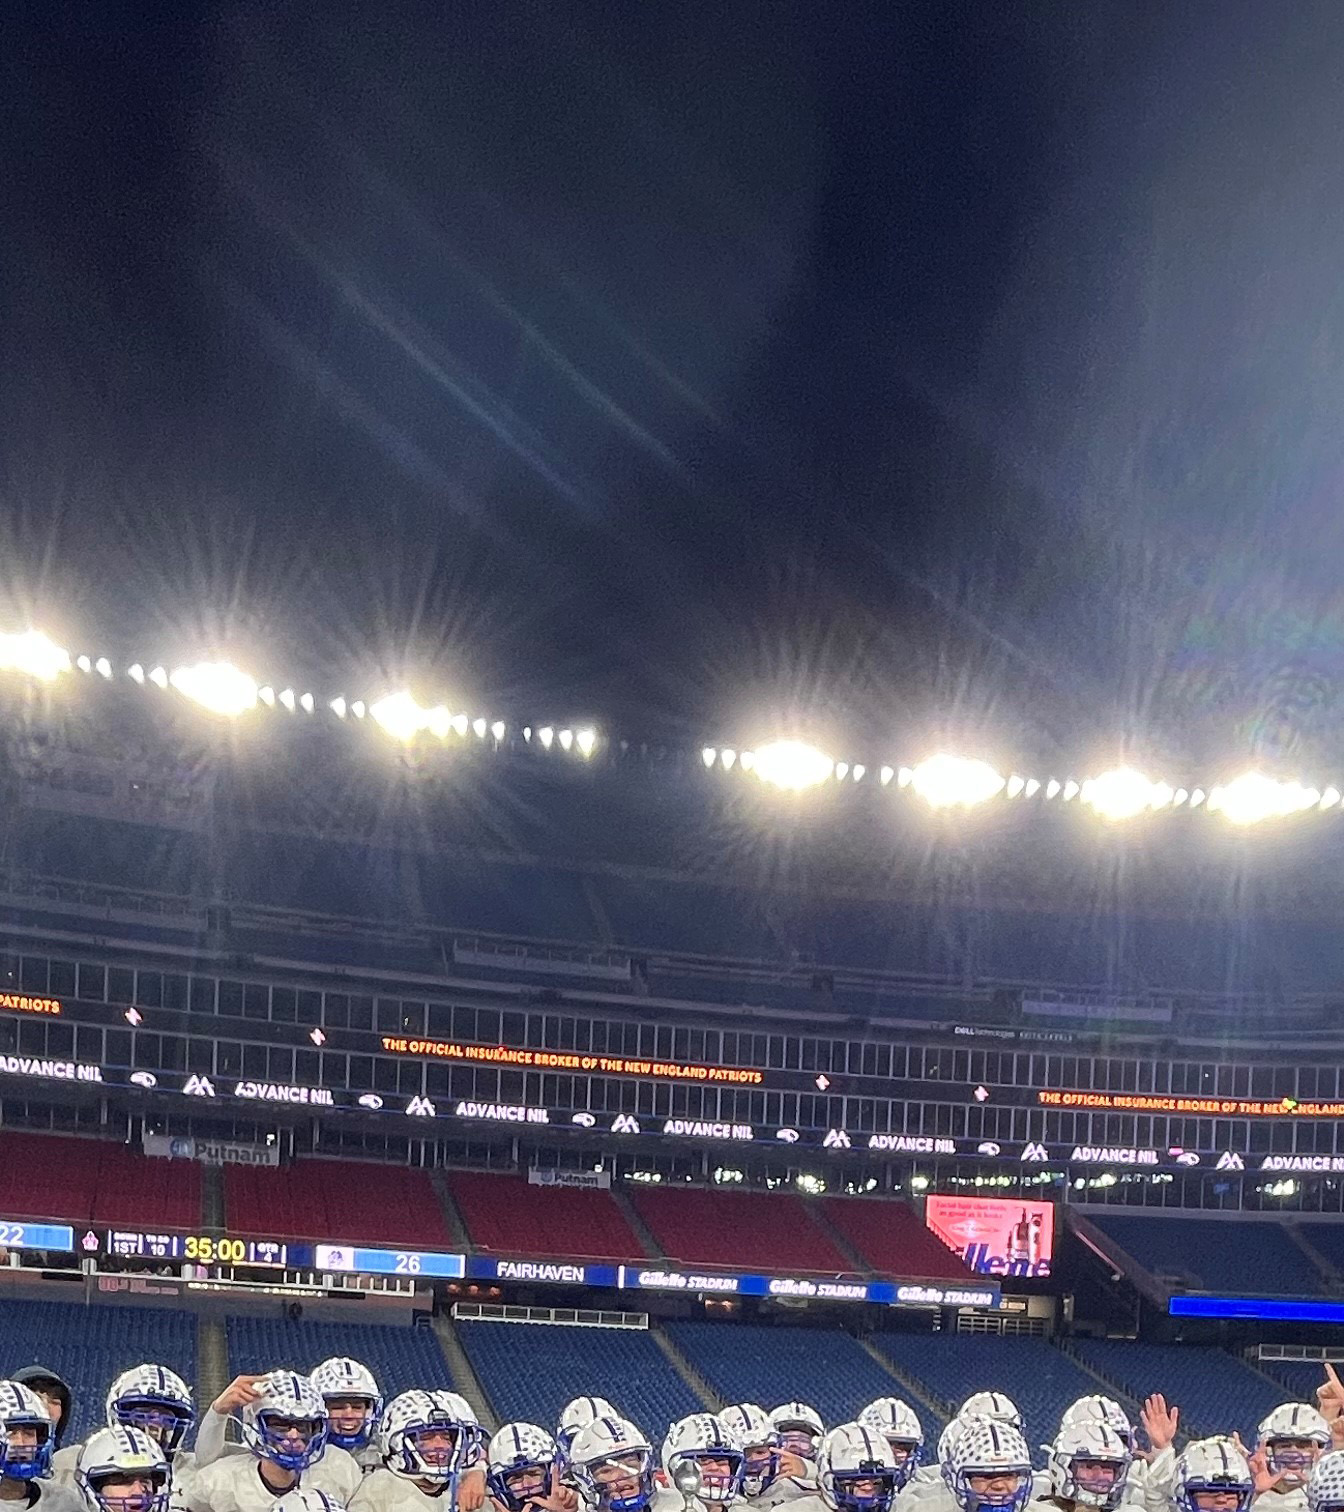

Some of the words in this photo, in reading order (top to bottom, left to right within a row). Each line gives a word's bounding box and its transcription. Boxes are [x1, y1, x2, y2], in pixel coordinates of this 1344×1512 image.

[382, 1038, 407, 1051] THE
[409, 1041, 463, 1057] OFFICIAL
[466, 1047, 532, 1064] INSURANCE
[535, 1053, 580, 1067] BROKER
[582, 1057, 597, 1069] OF
[600, 1059, 622, 1072] THE
[625, 1062, 651, 1074] NEW
[653, 1064, 706, 1078] ENGLAND
[709, 1068, 762, 1083] PATRIOTS
[78, 1066, 102, 1081] NIL
[235, 1081, 308, 1102] ADVANCE
[311, 1089, 334, 1104] NIL
[1039, 1092, 1060, 1104] THE
[1063, 1094, 1111, 1106] OFFICIAL
[1114, 1096, 1175, 1109] INSURANCE
[1177, 1100, 1219, 1111] BROKER
[1222, 1102, 1237, 1112] OF
[1239, 1102, 1260, 1113] THE
[456, 1102, 525, 1122] ADVANCE
[527, 1109, 549, 1123] NIL
[664, 1120, 730, 1138] ADVANCE
[733, 1125, 754, 1139] NIL
[869, 1134, 933, 1152] ADVANCE
[935, 1138, 956, 1153] NIL
[194, 1143, 270, 1164] Putnam
[1072, 1146, 1136, 1163] ADVANCE
[1138, 1150, 1159, 1164] NIL
[1261, 1156, 1330, 1170] ADVANCE
[151, 1243, 166, 1256] 10
[184, 1236, 246, 1261] 35:00
[396, 1254, 420, 1273] 26
[497, 1261, 584, 1282] FAIRHAVEN
[687, 1276, 738, 1290] STADIUM
[818, 1284, 867, 1299] STADIUM
[944, 1291, 992, 1306] STADIUM
